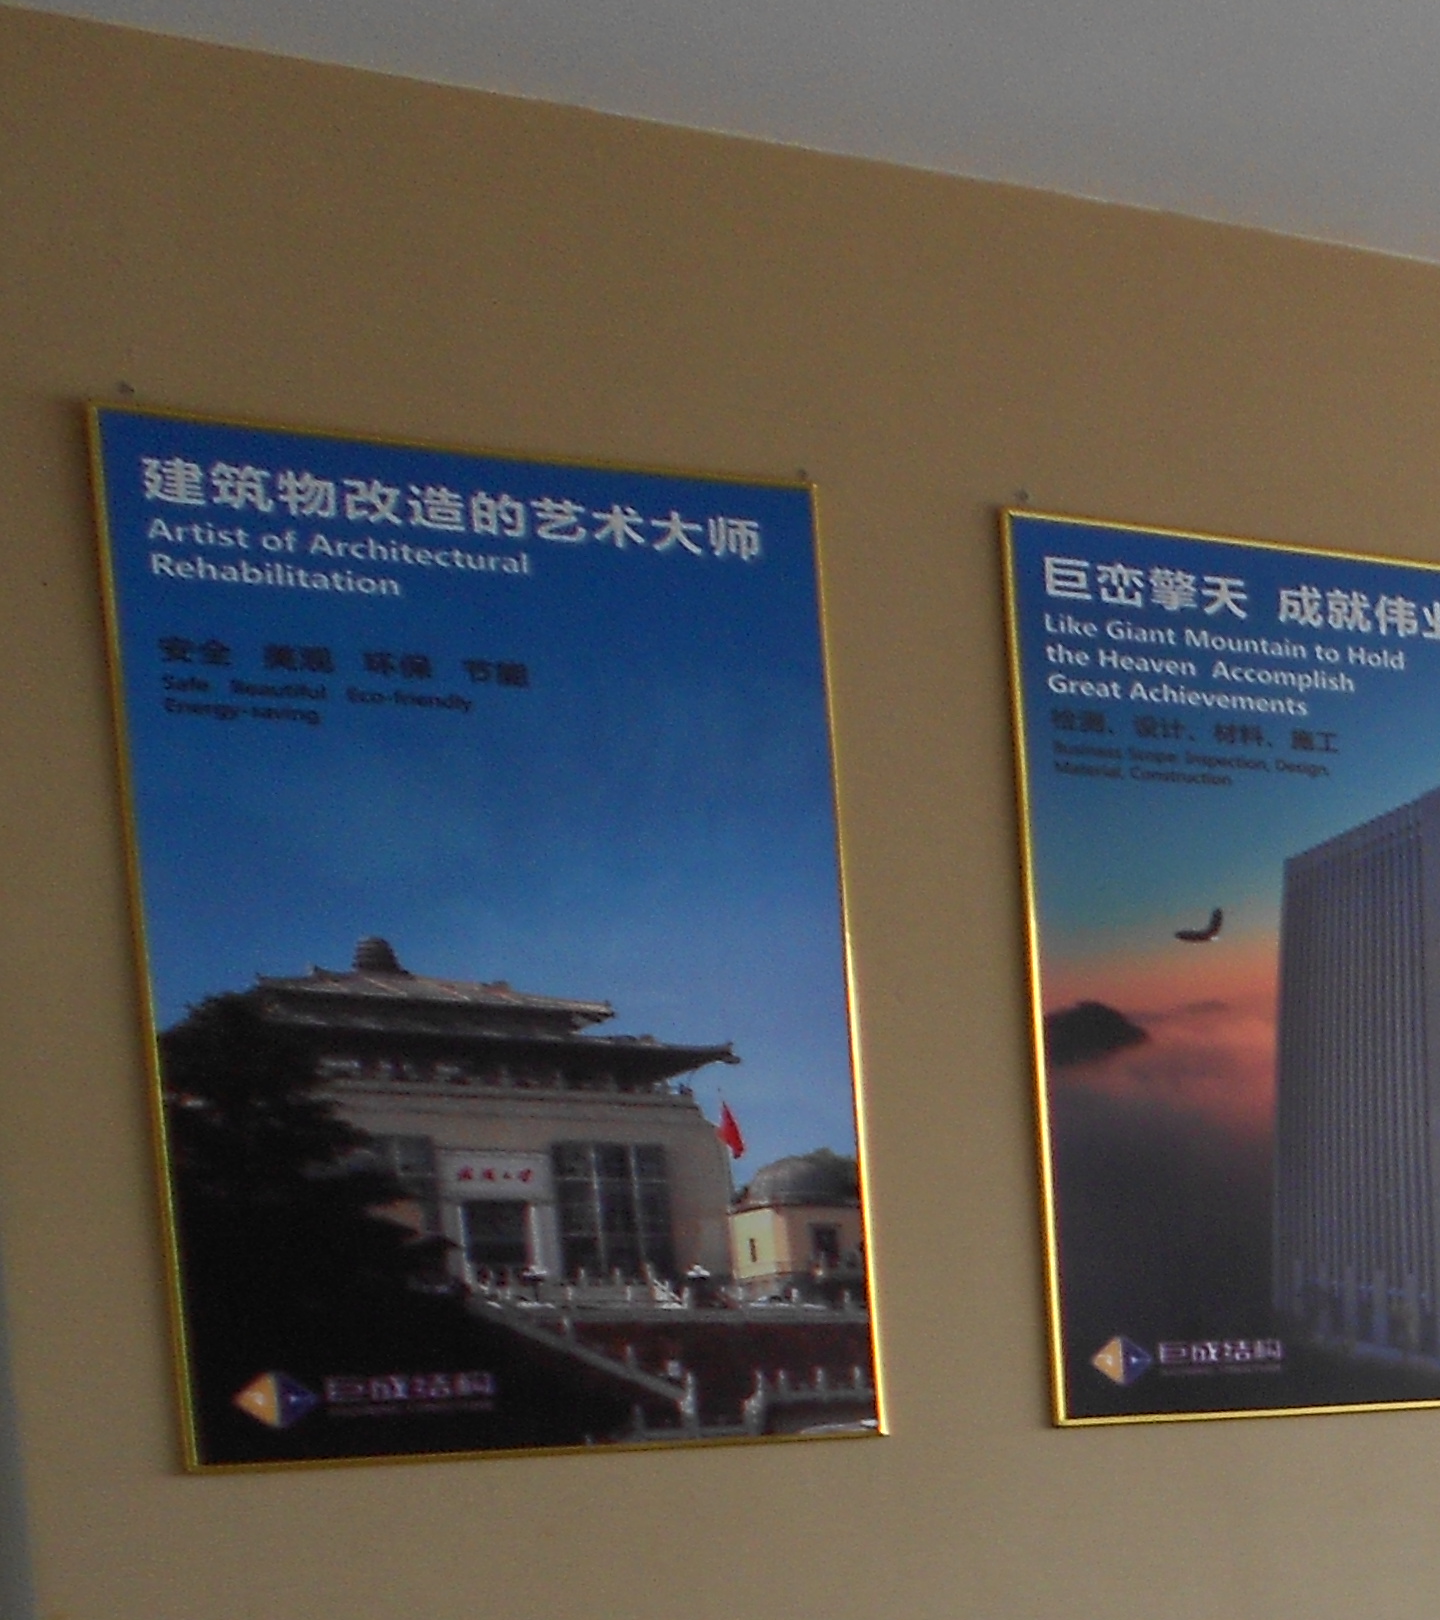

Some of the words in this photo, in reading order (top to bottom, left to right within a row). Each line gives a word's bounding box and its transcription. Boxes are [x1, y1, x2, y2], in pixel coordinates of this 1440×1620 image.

[141, 456, 762, 564] 建筑物改造的艺术大师
[147, 517, 249, 550] Artist
[262, 528, 297, 553] of
[310, 533, 530, 576] Architectural
[151, 554, 402, 597] Rehabilitation
[1043, 555, 1249, 621] 巨峦擎天
[1044, 612, 1098, 638] Like
[1106, 618, 1176, 646] Giant
[1185, 628, 1307, 661] Mountain
[1315, 641, 1341, 664] to
[1348, 646, 1406, 672] Hold
[1045, 642, 1089, 667] the
[1099, 648, 1197, 677] Heaven
[1212, 660, 1356, 694] Accomplish
[1047, 673, 1121, 701] Great
[1130, 682, 1308, 717] Achievements
